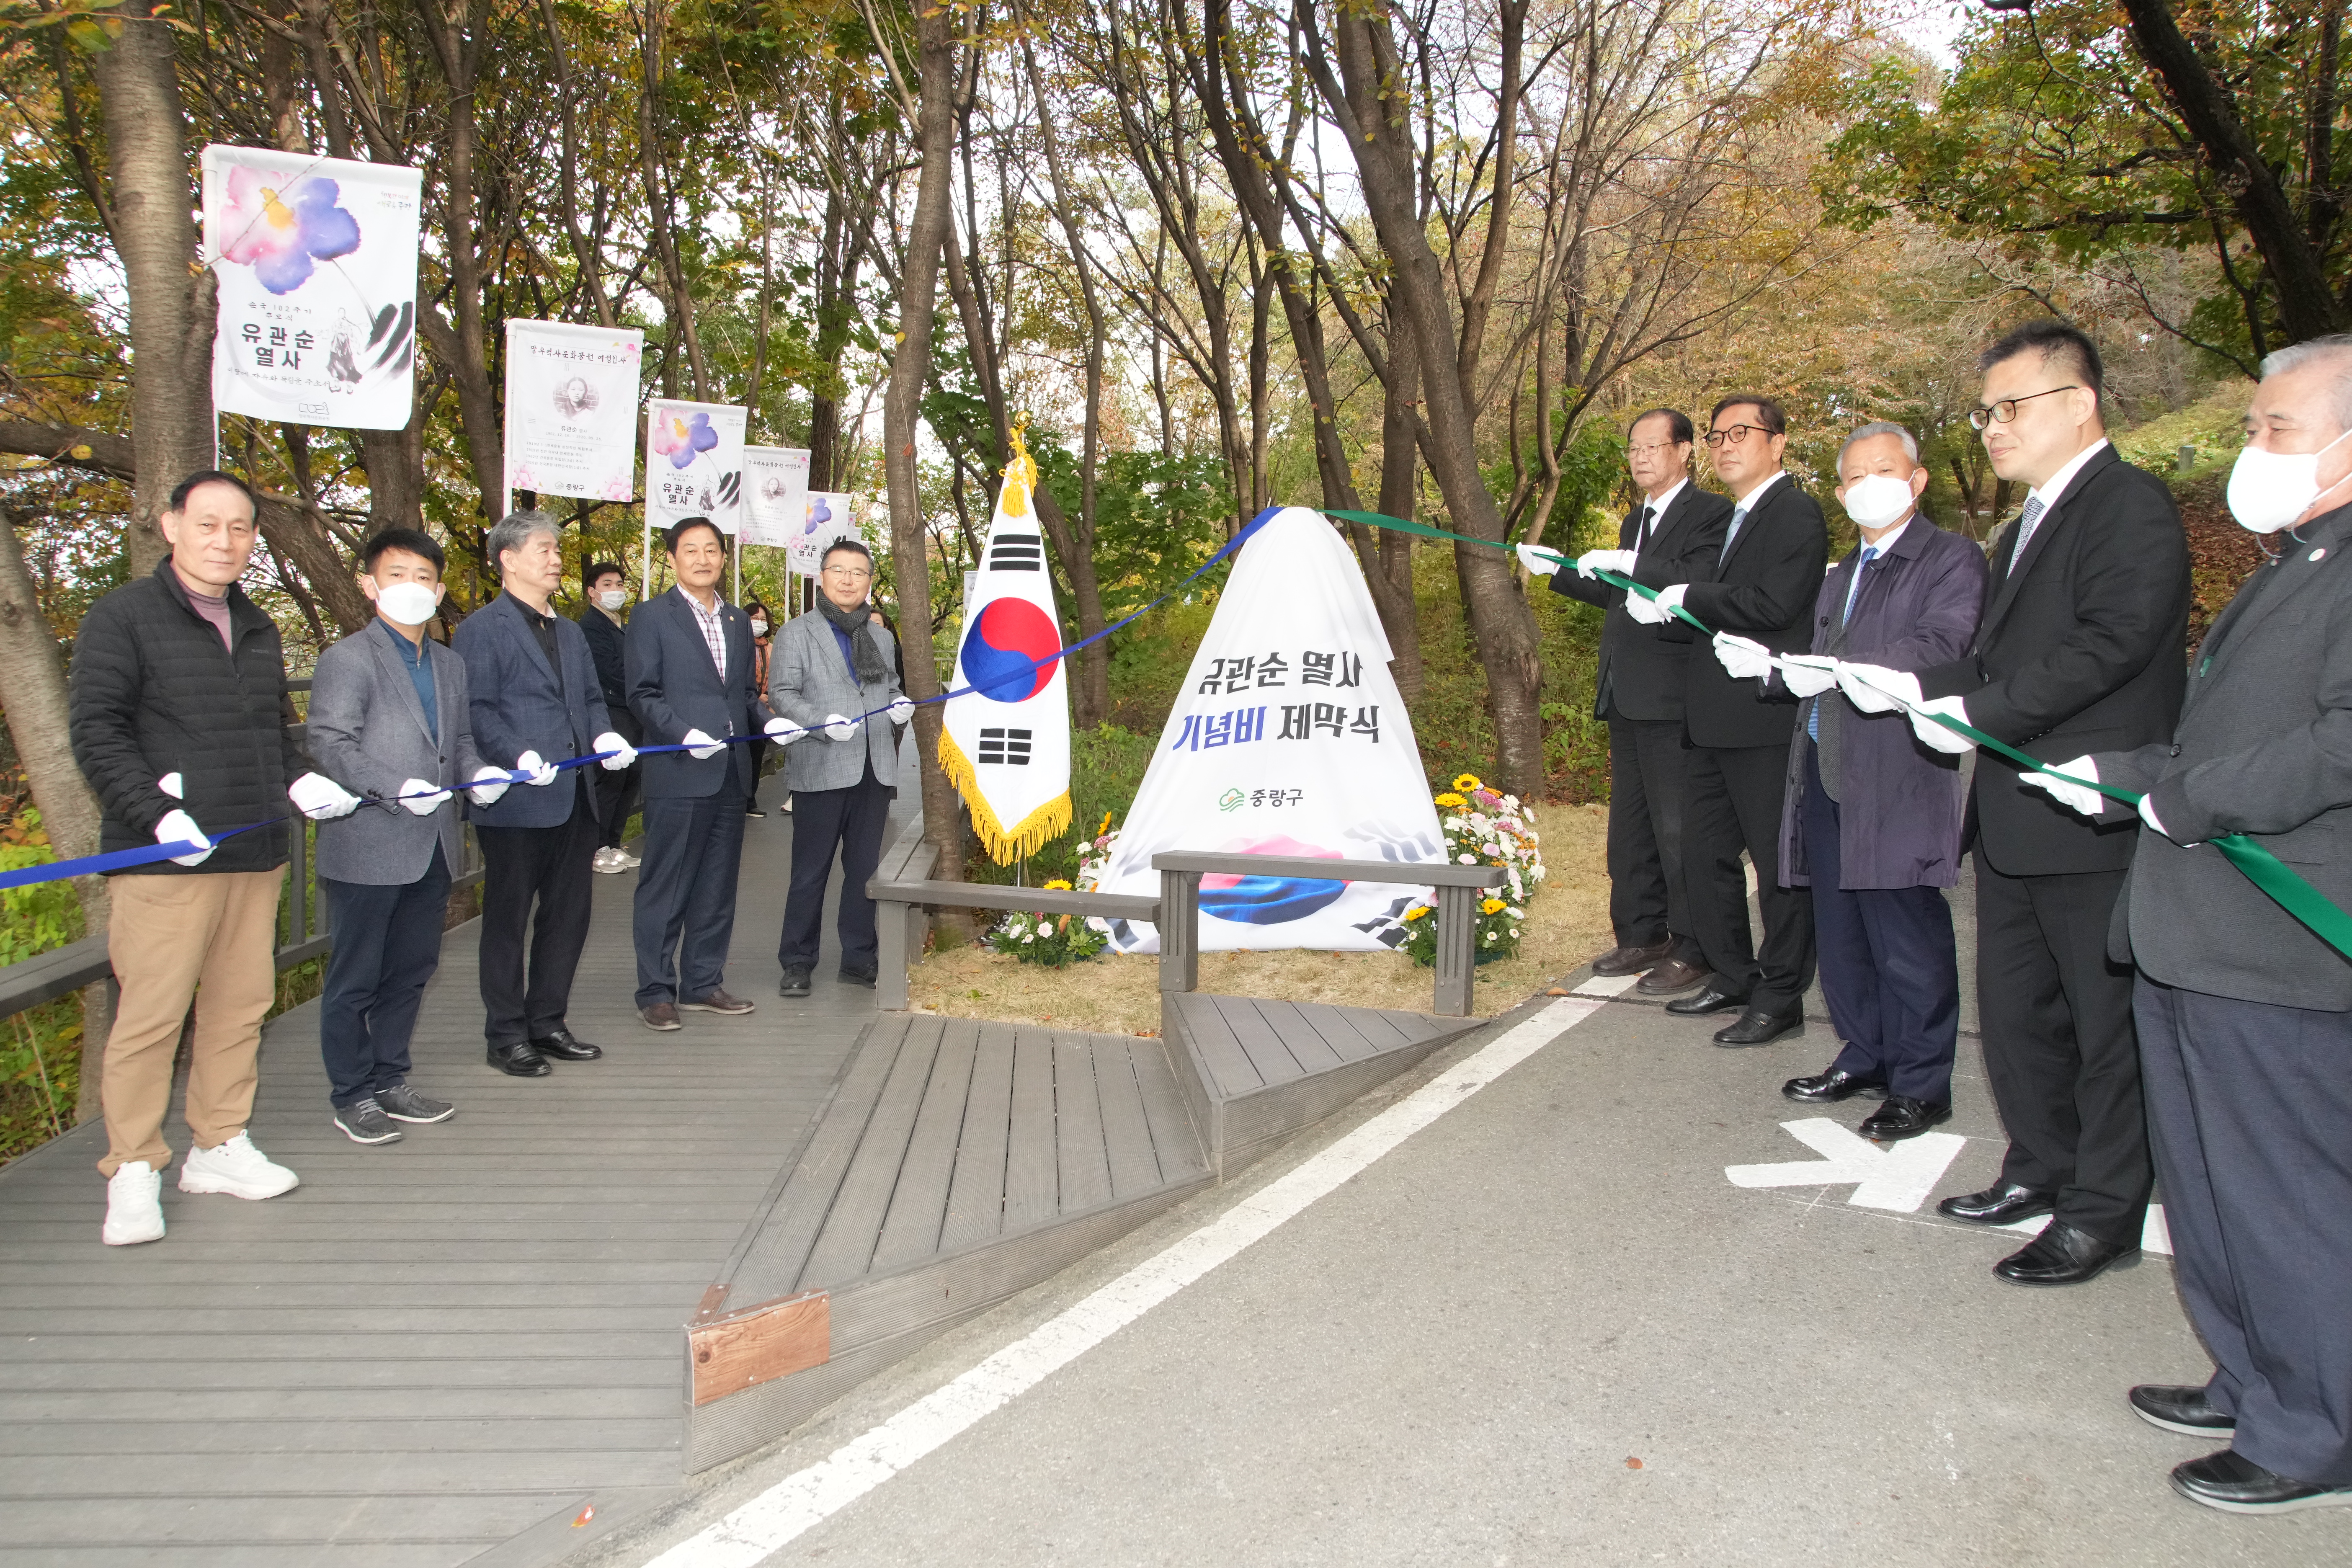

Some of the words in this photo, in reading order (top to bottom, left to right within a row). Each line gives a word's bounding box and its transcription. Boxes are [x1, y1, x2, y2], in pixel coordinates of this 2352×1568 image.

[266, 312, 293, 321] 추모식
[273, 304, 311, 314] 102주기
[242, 323, 314, 349] 유관순
[255, 347, 301, 370] 열사
[531, 345, 593, 361] 망우역사문화공원
[598, 355, 626, 364] 여성인사
[252, 373, 277, 382] 자유와
[281, 377, 302, 385] 독립을
[663, 483, 694, 495] 유관순
[669, 494, 688, 505] 열사
[1302, 650, 1364, 688] 열사
[1173, 706, 1267, 752] 기념비
[1277, 702, 1380, 744] 제막식
[1250, 789, 1304, 807] 중랑구
